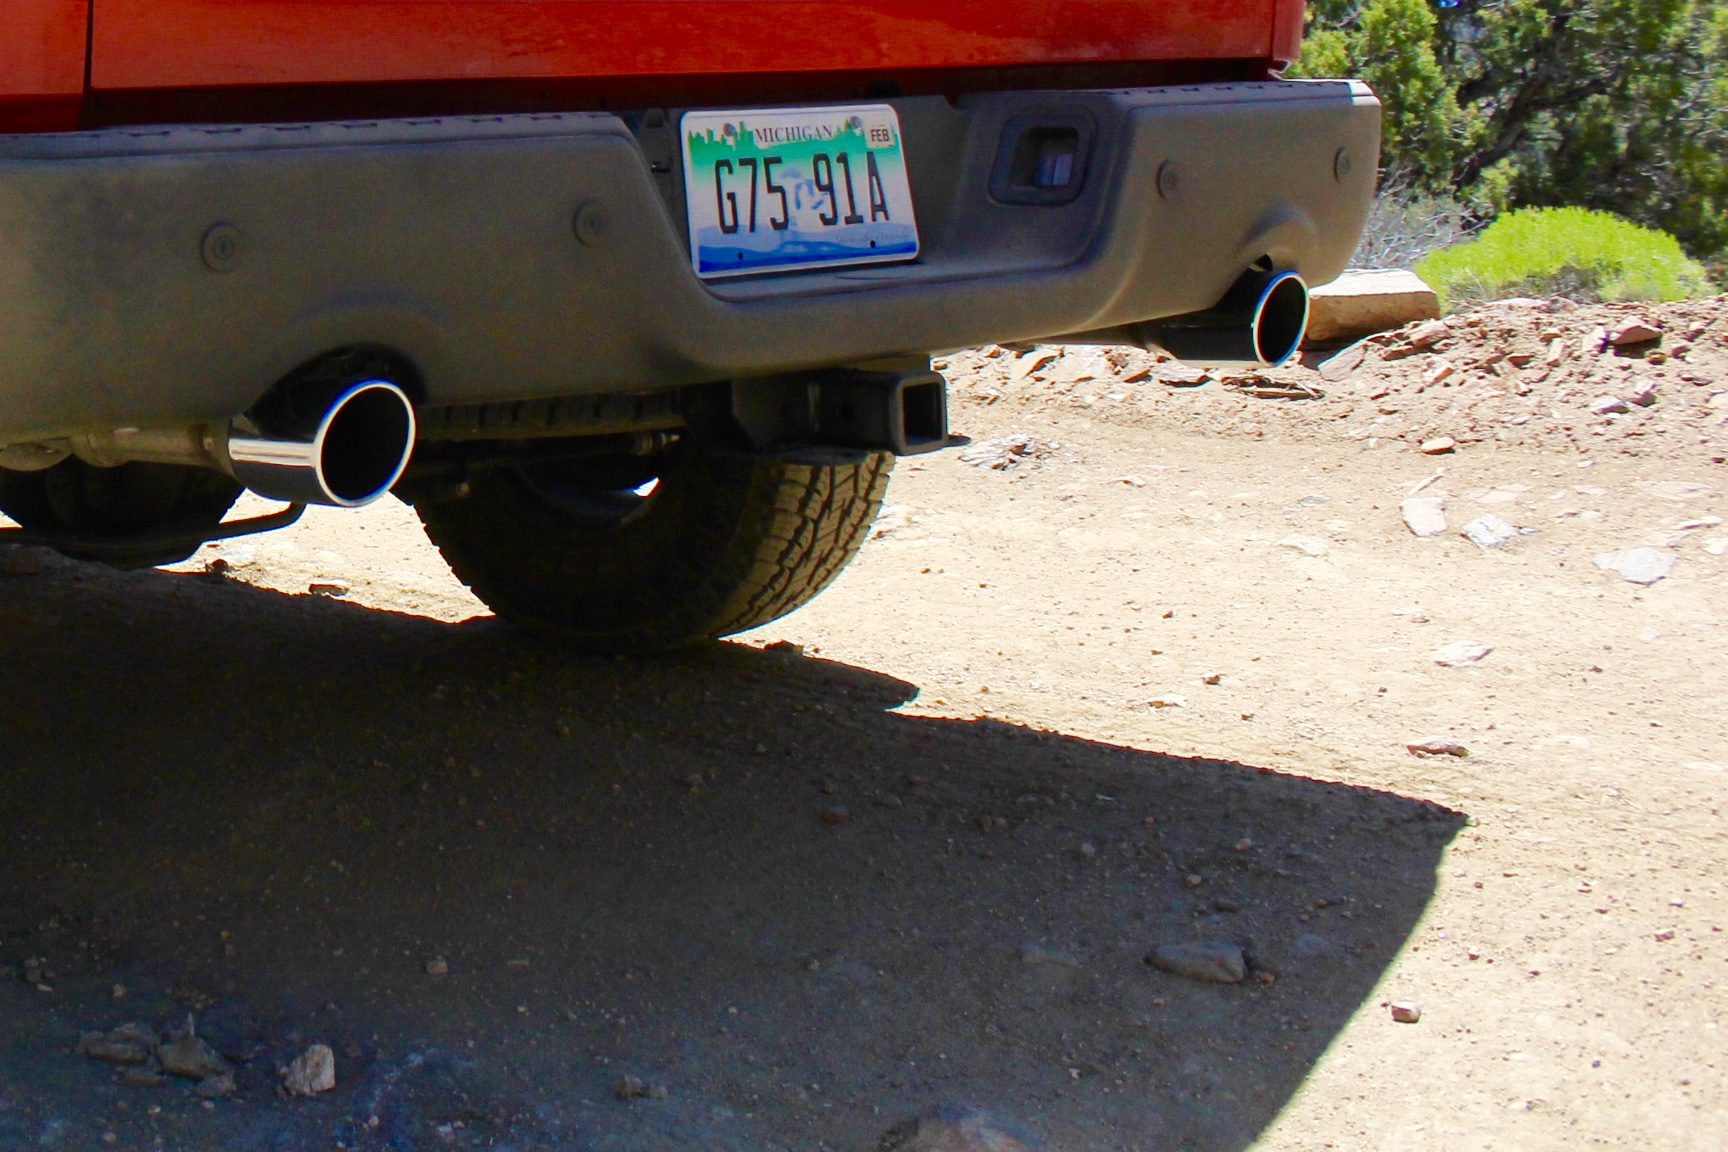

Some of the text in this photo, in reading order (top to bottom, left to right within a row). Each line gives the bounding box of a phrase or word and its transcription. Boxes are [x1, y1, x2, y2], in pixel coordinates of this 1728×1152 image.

[754, 124, 834, 144] MICHIGAN
[870, 127, 891, 143] FEB
[714, 151, 890, 235] G75 91A
